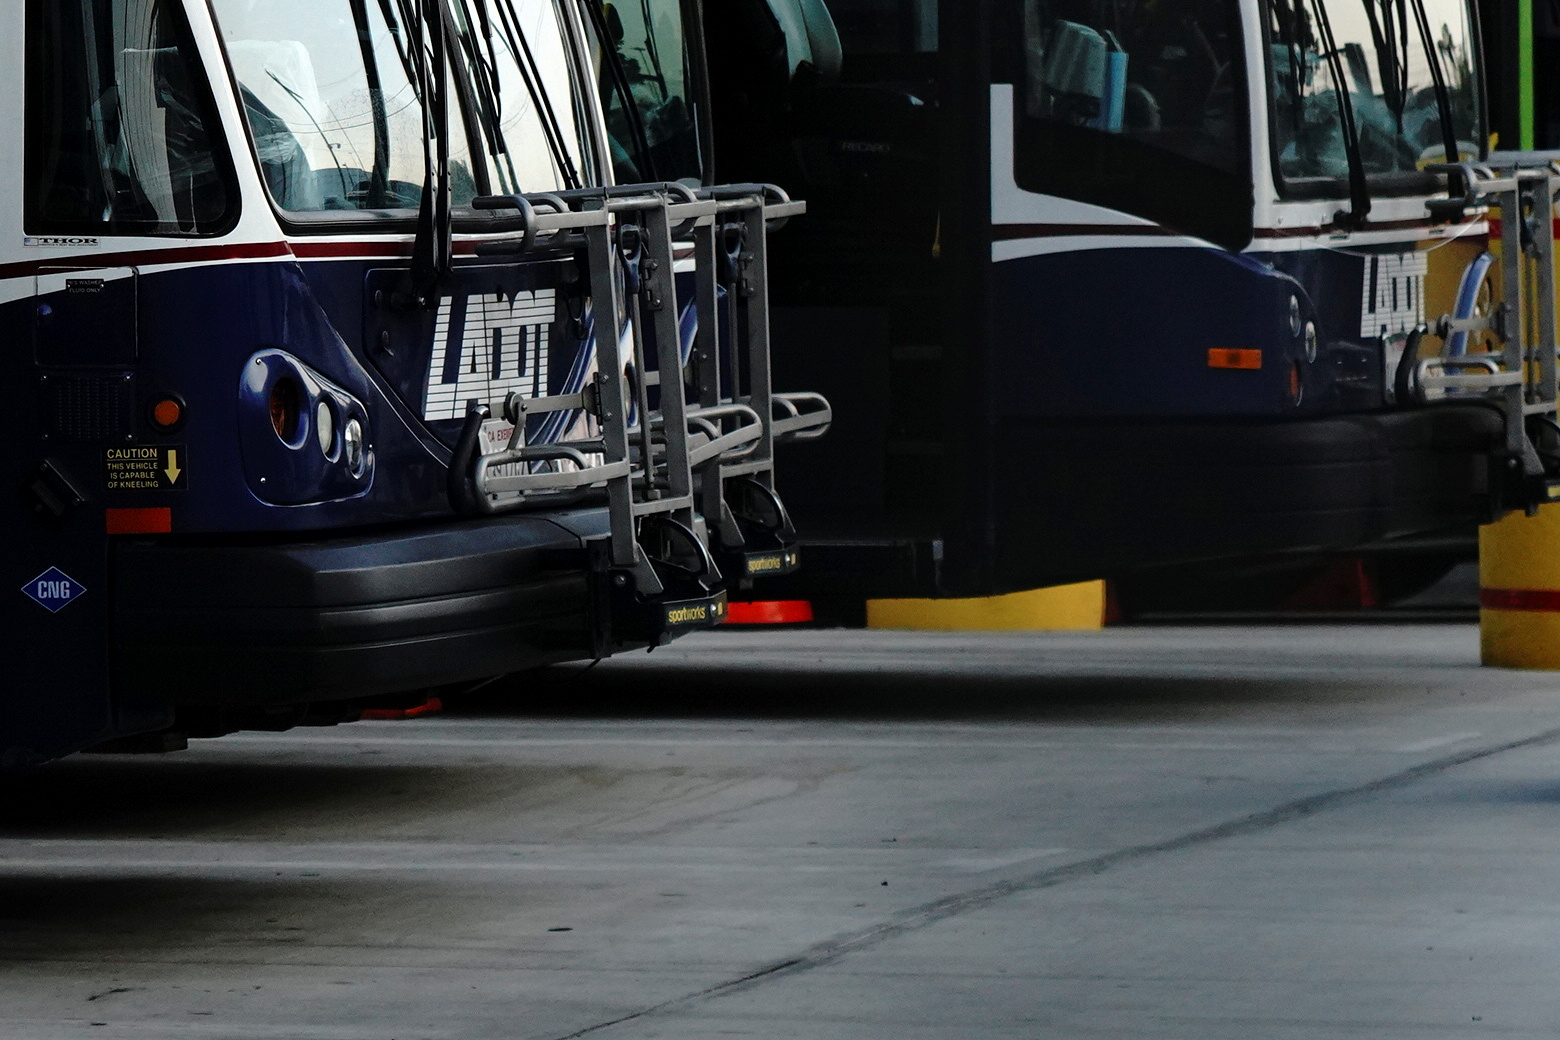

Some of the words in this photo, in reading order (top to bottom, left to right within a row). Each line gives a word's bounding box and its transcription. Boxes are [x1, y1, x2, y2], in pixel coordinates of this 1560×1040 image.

[424, 288, 556, 421] LADOT
[106, 448, 158, 459] CAUTION
[125, 462, 159, 470] VEHICLE
[119, 471, 155, 479] CAPABLE
[107, 481, 119, 489] OF
[120, 480, 159, 489] KNEELING
[37, 580, 71, 599] CNG
[668, 606, 706, 624] sportworks
